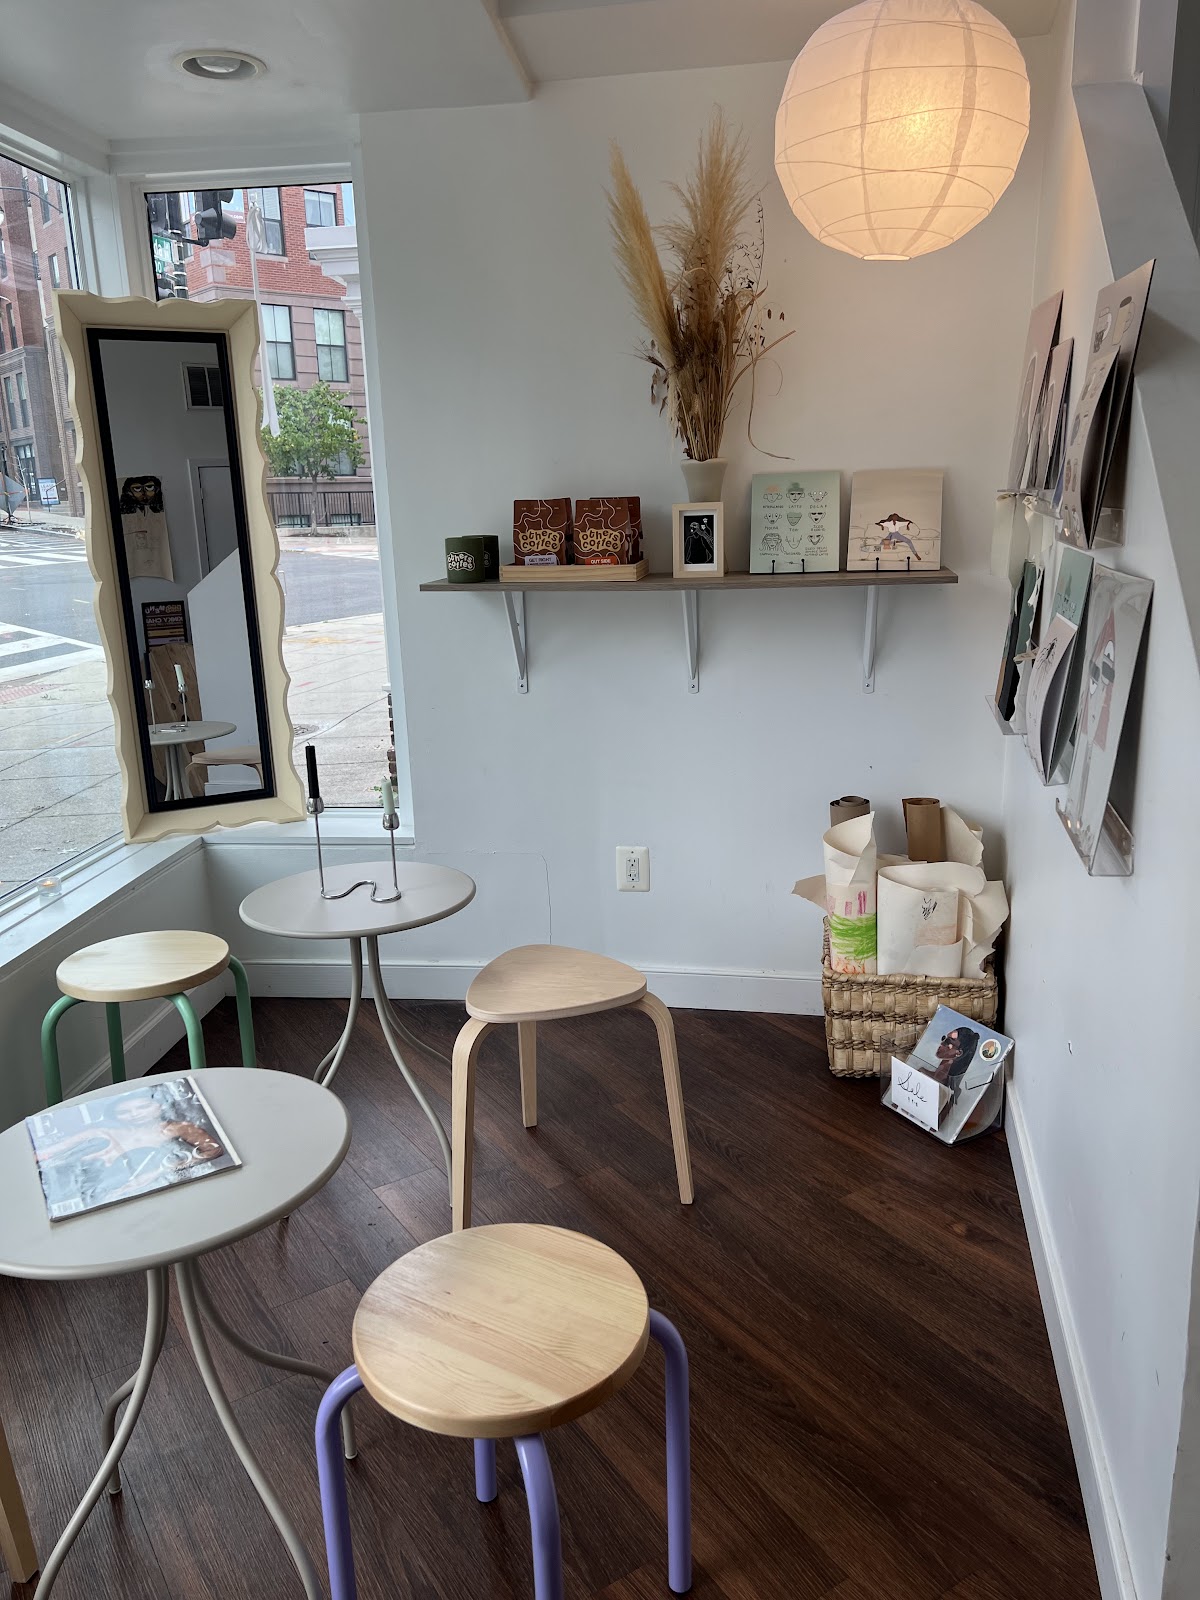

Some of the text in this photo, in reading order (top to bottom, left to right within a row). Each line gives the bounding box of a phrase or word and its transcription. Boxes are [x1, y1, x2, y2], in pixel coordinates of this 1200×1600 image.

[521, 530, 558, 542] others
[581, 530, 619, 542] others
[522, 537, 558, 550] coffee
[582, 537, 619, 550] coffee
[447, 553, 473, 563] others
[448, 559, 473, 569] coffee
[33, 1078, 192, 1137] ELE
